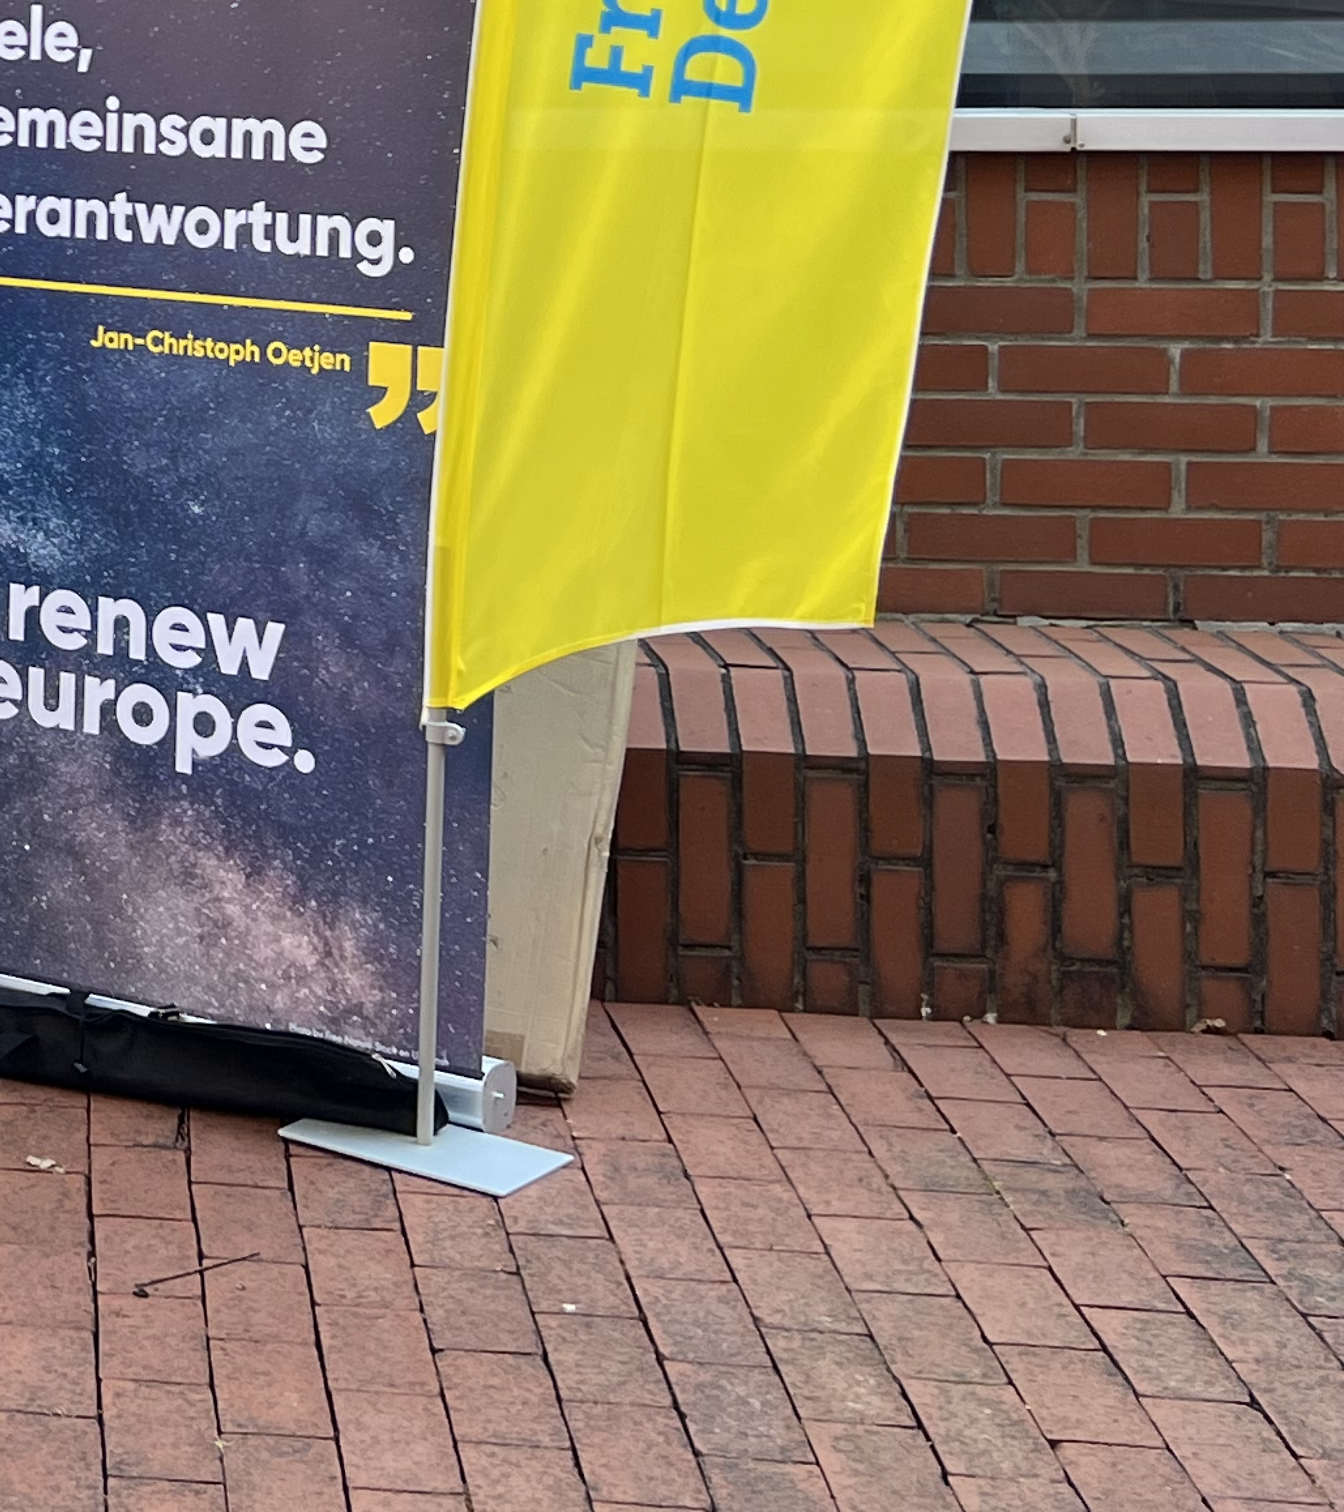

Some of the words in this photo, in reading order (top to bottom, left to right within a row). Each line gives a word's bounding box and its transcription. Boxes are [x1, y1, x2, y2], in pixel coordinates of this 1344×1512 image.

[90, 325, 260, 366] Jan-Christoph
[266, 341, 351, 375] Oetjen
[6, 580, 285, 682] renew
